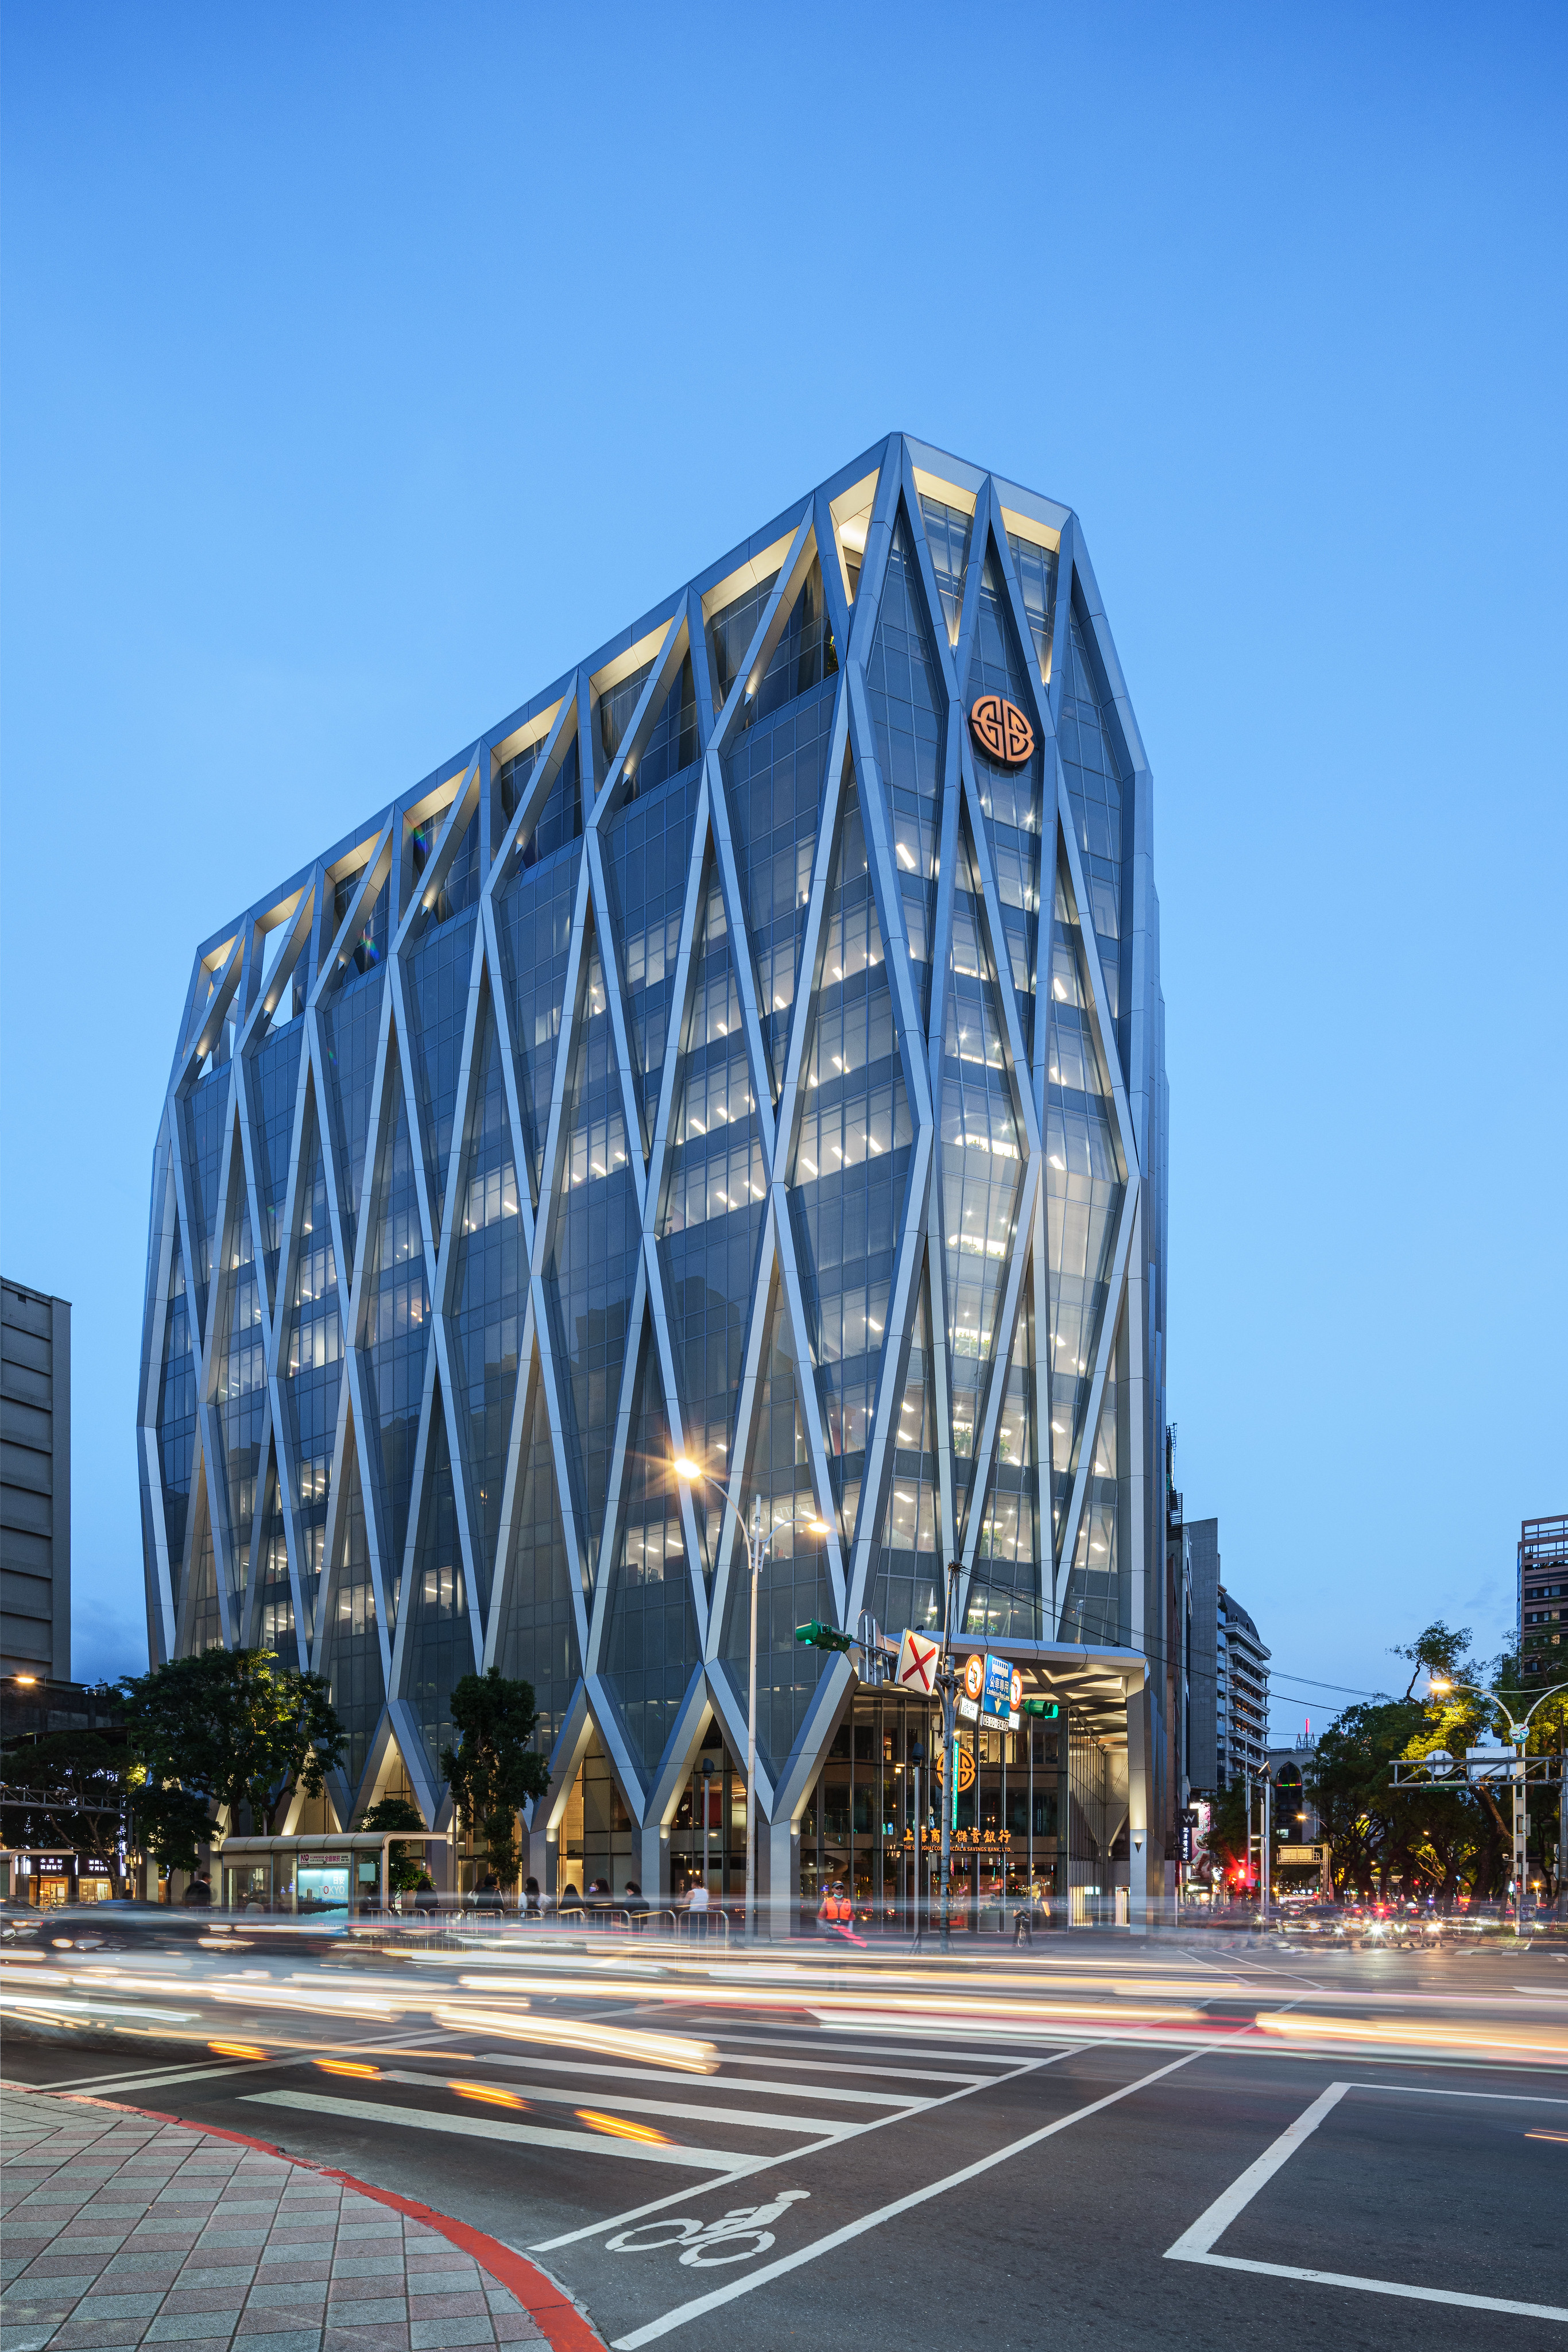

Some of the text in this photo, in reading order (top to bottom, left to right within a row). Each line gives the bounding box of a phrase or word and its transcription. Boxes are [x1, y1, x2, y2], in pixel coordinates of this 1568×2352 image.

[990, 1676, 1009, 1693] 公車專用
[986, 1687, 1000, 1697] Exclusive
[903, 1828, 1011, 1844] 上海商儲蓄銀行
[333, 1877, 345, 1885] 日安
